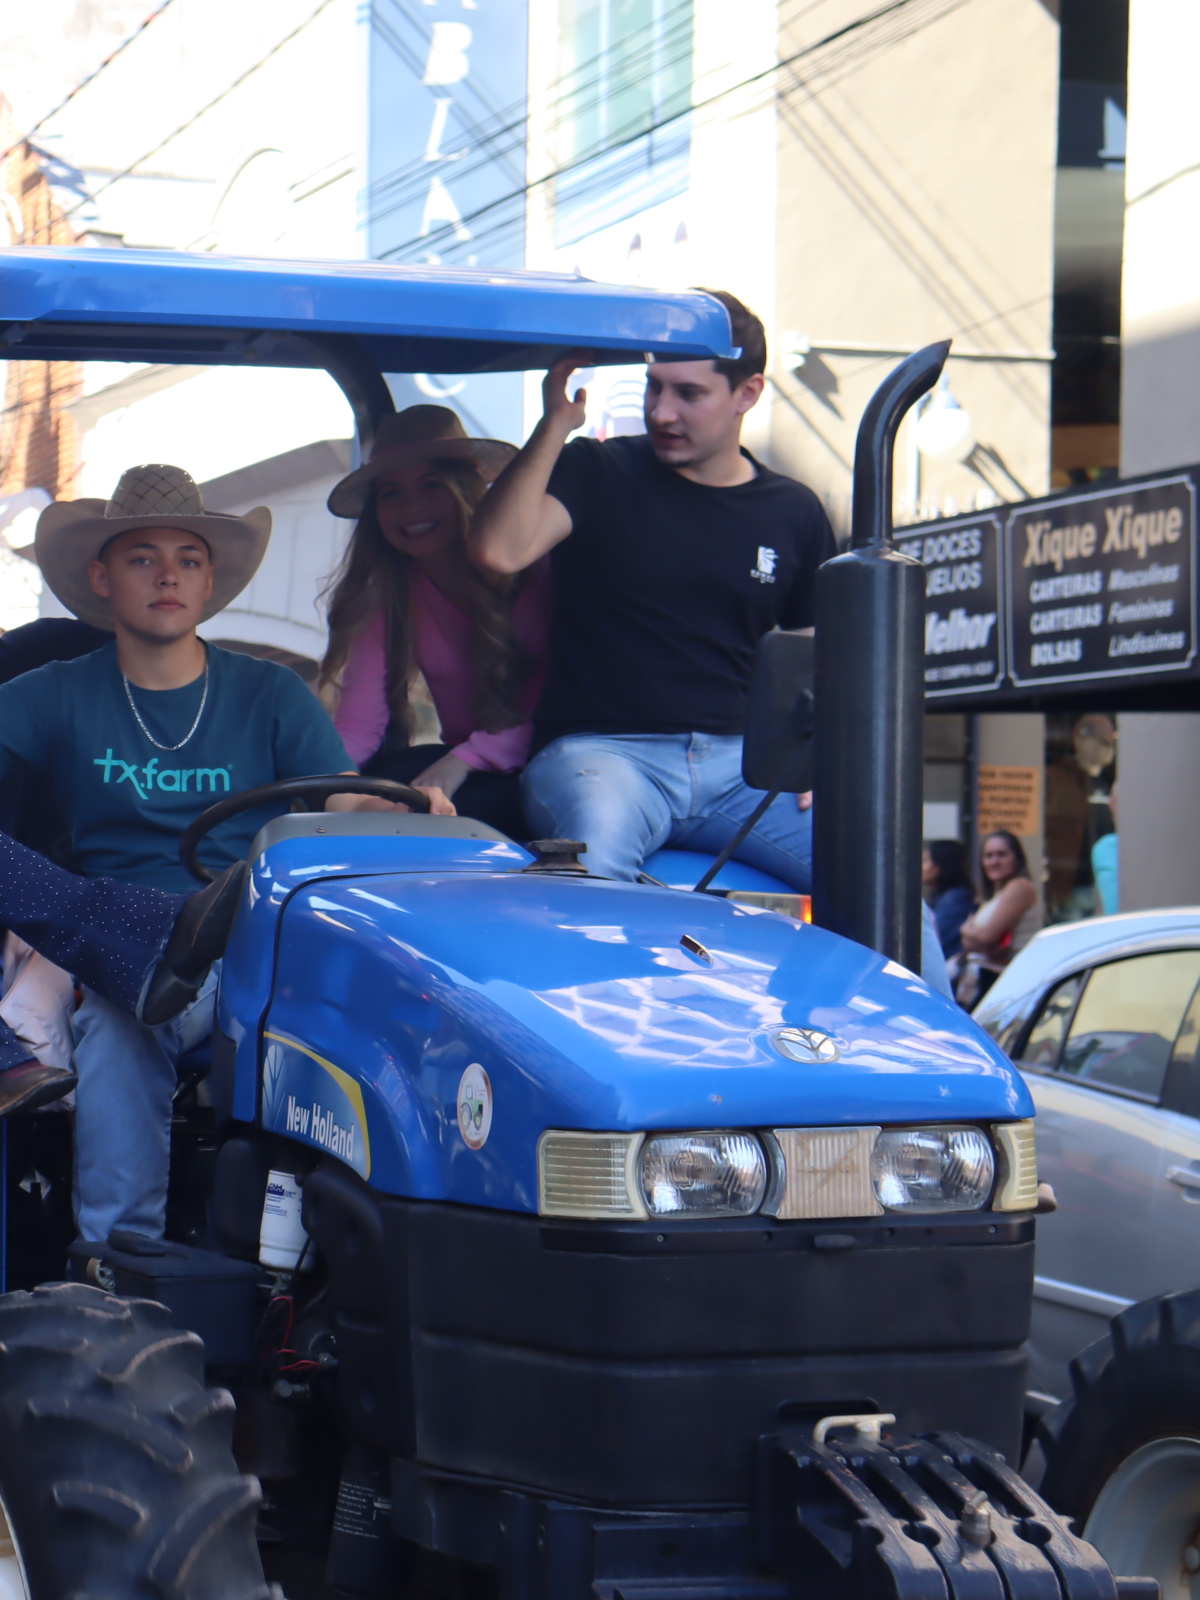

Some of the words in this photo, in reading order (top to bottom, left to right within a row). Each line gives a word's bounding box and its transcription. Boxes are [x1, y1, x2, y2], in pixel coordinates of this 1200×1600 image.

[922, 528, 983, 566] DOCES
[1022, 519, 1097, 572] Xique
[1102, 500, 1183, 559] Xique
[1107, 562, 1180, 592] Masculinas
[1107, 597, 1175, 625] Femininas
[1030, 638, 1083, 667] BOLSAS
[286, 1095, 311, 1136] New
[310, 1102, 355, 1162] Holland
